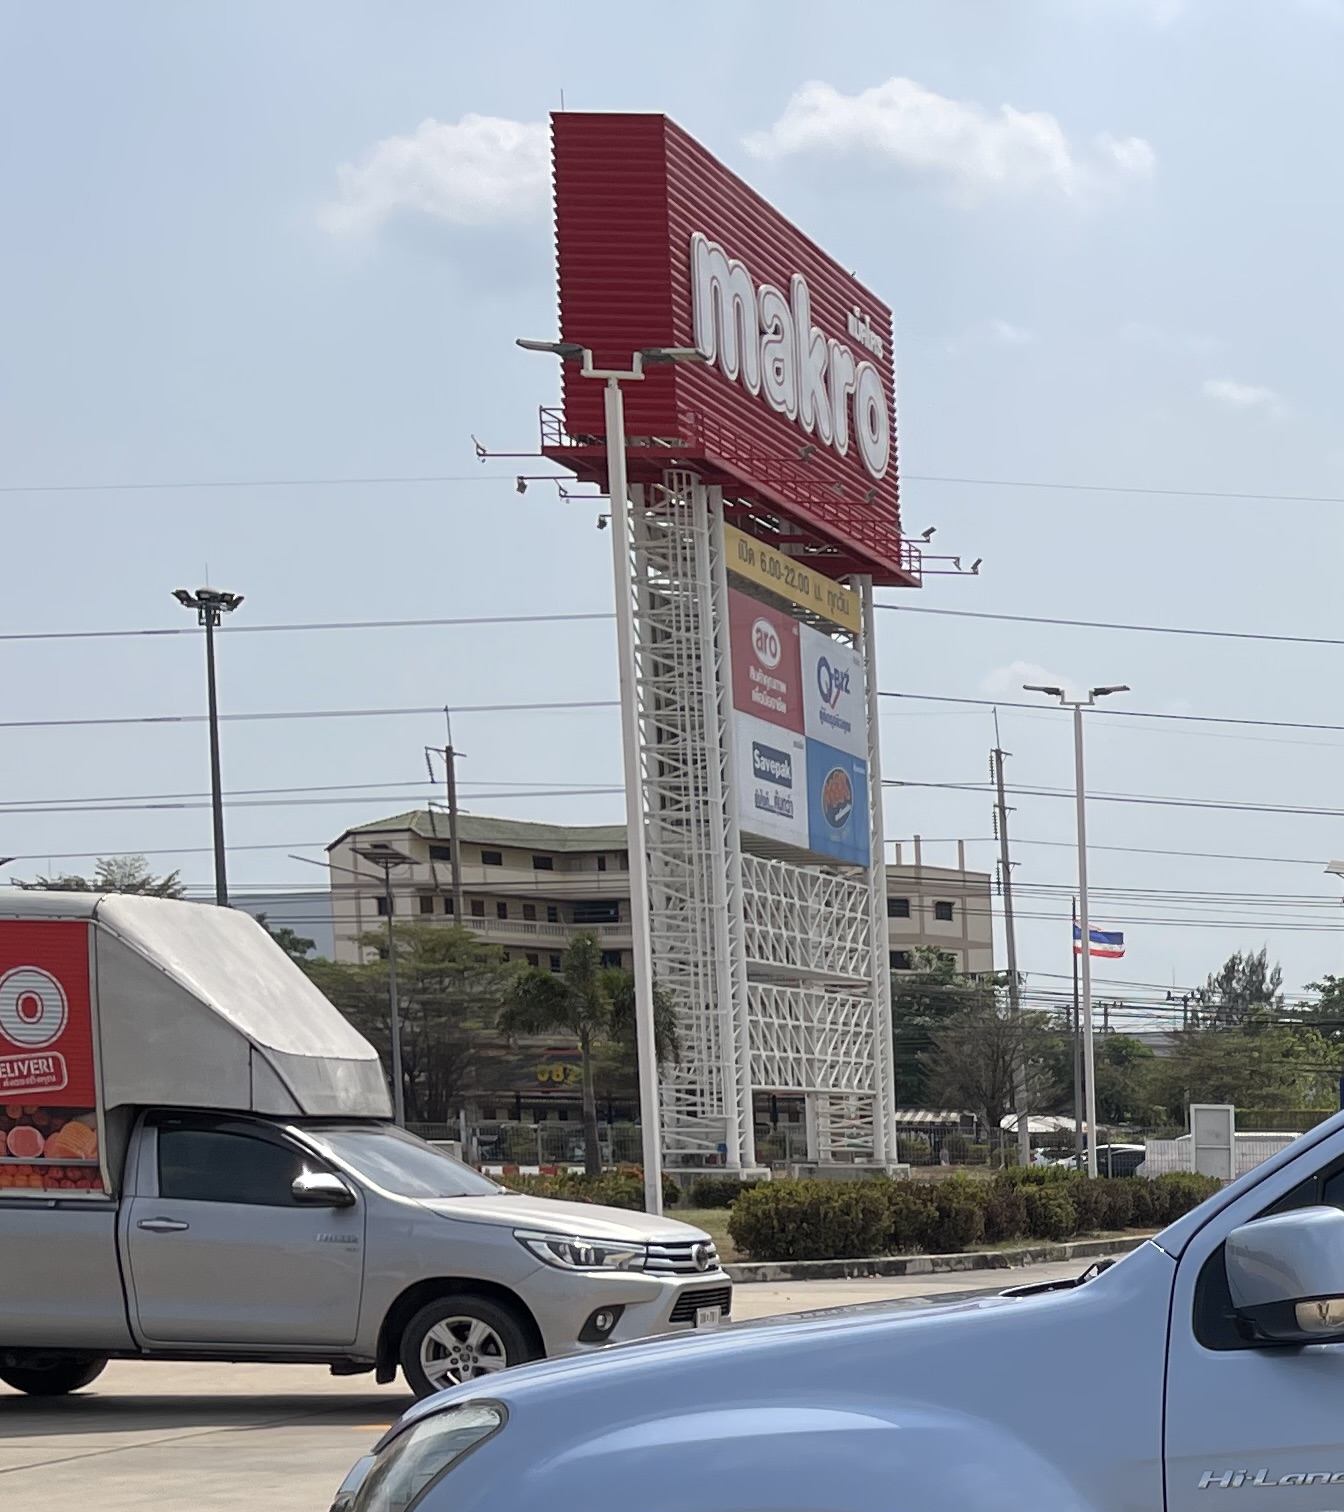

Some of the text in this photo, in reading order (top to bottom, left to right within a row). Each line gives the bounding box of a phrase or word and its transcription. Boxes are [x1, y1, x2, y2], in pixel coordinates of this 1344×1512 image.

[690, 231, 891, 480] makro
[759, 551, 810, 595] 6.00-22.00
[755, 627, 778, 659] aro
[753, 749, 792, 779] Savepak
